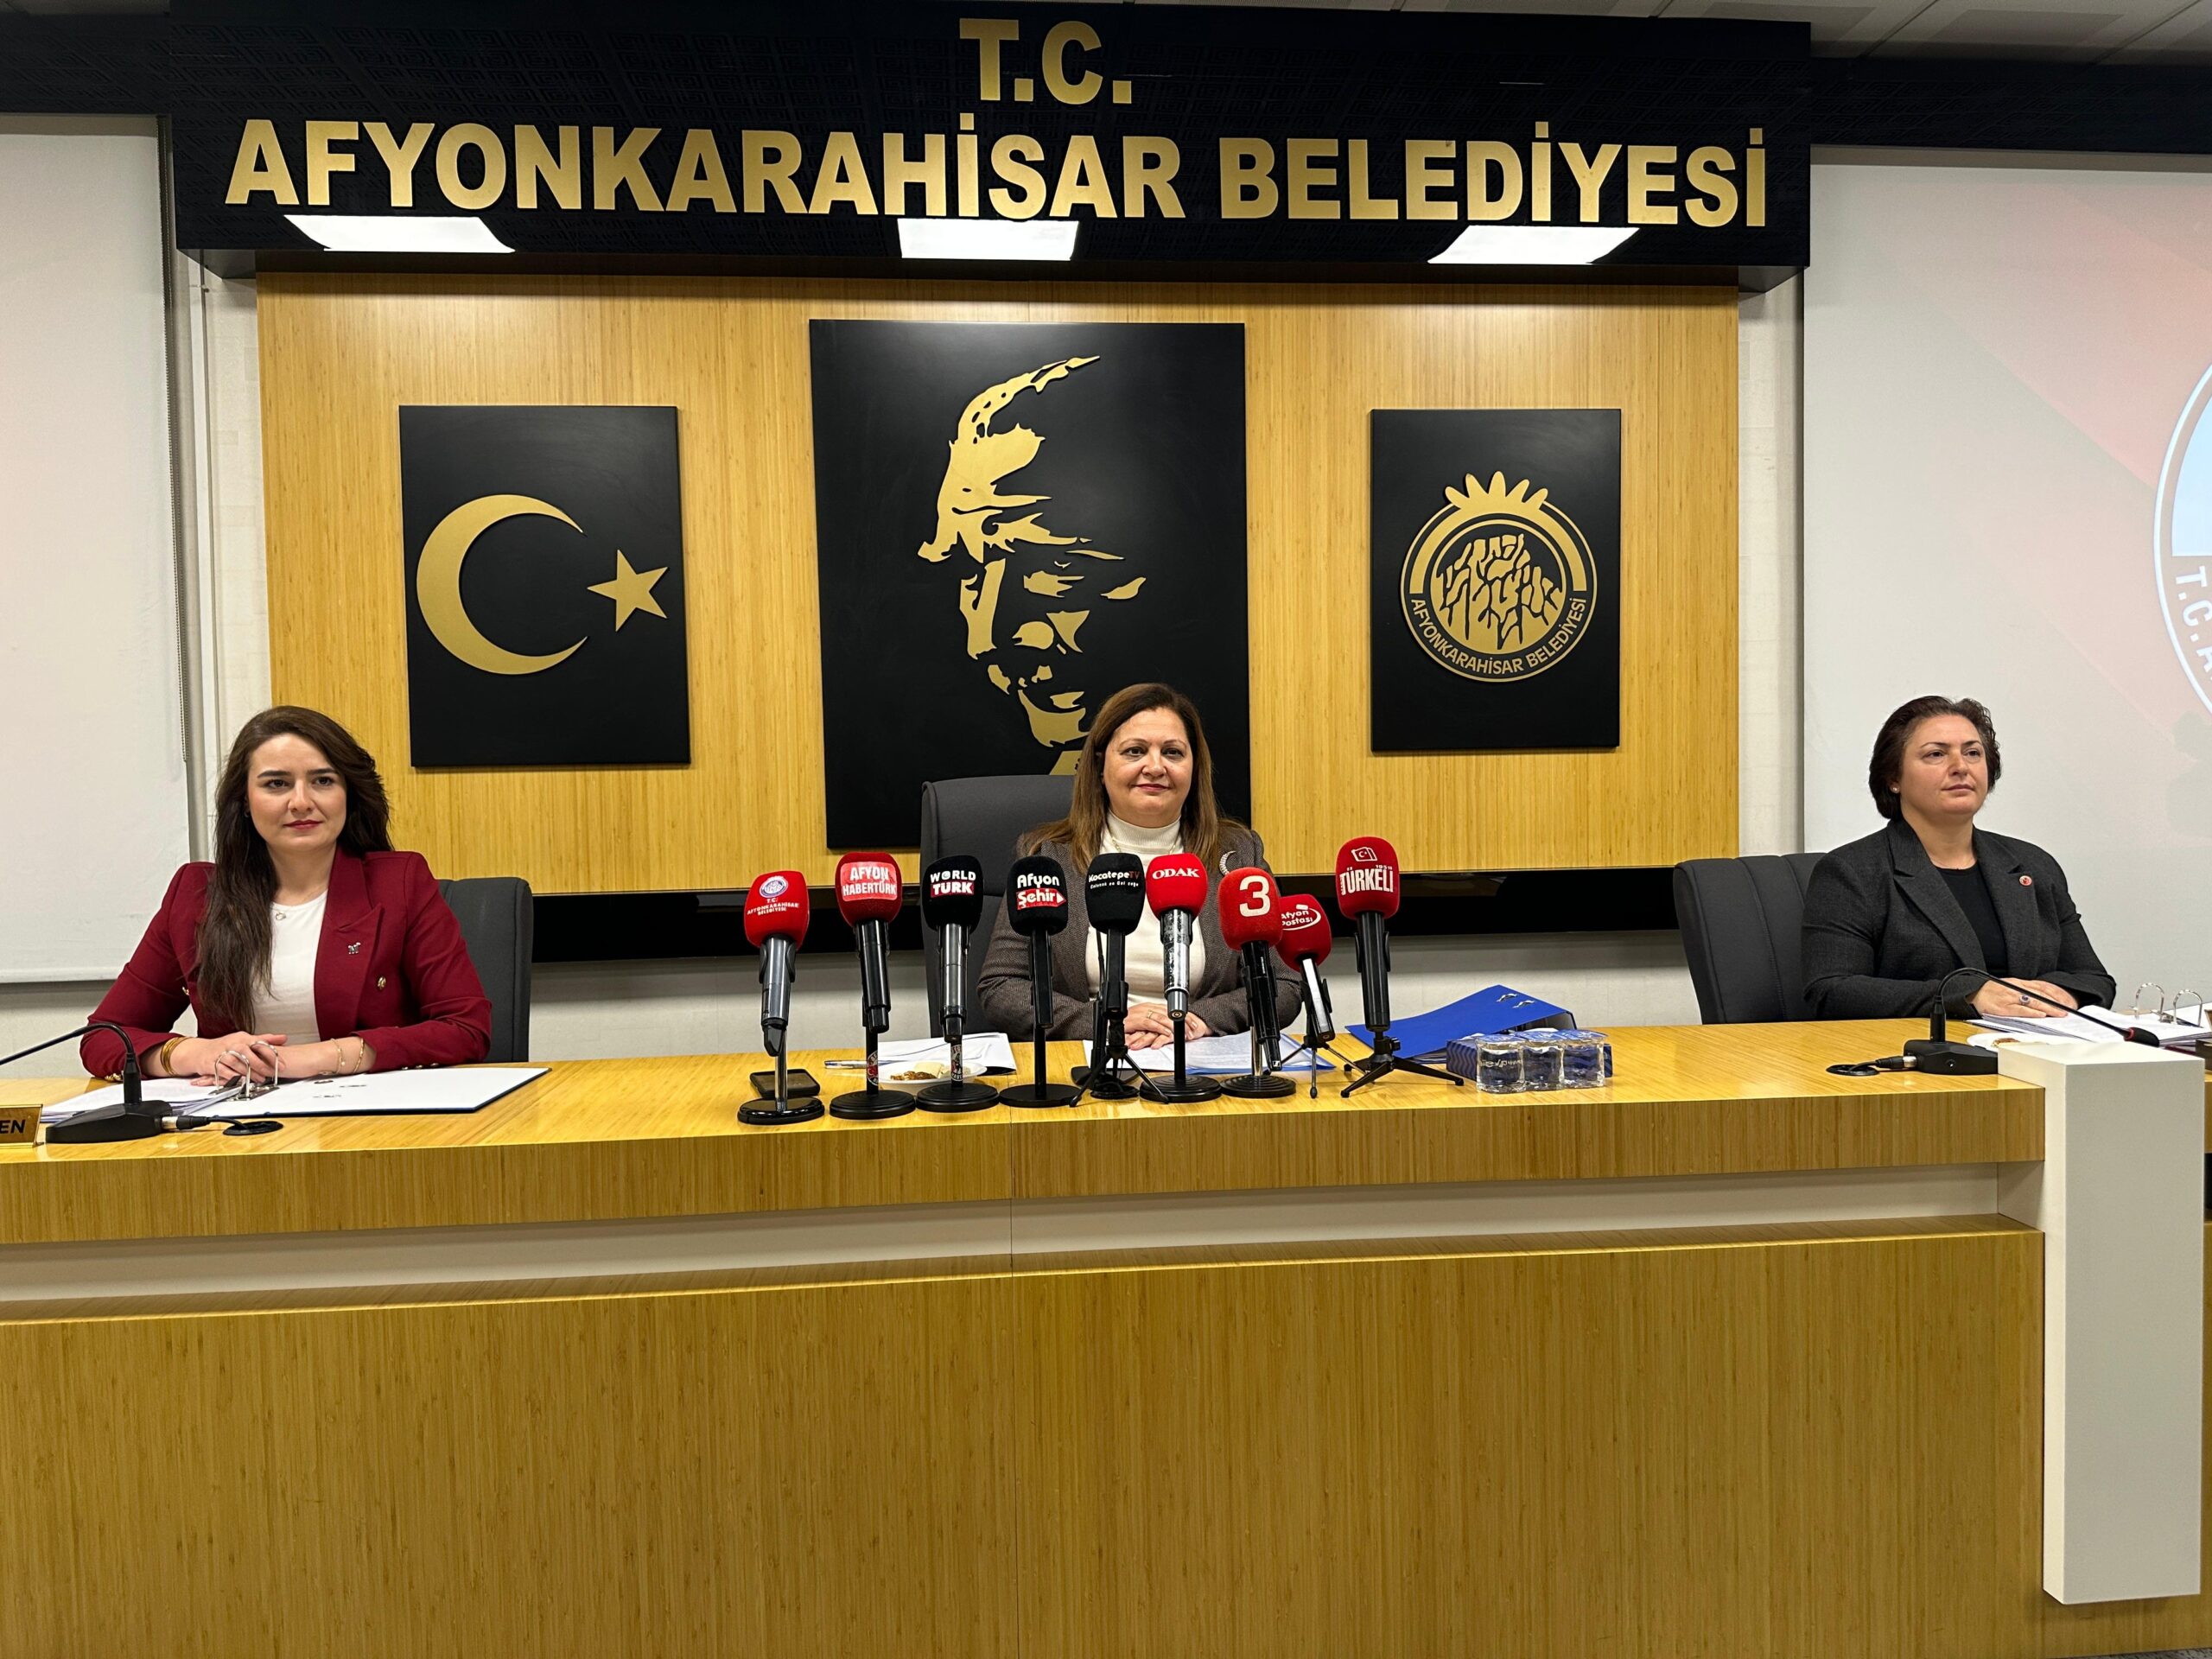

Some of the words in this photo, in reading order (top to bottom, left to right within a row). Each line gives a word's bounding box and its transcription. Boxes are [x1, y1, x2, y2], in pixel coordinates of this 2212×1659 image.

[958, 19, 1134, 105] T.C.
[225, 112, 1184, 221] AFYONKARAHİSAR
[1218, 120, 1767, 228] BELEDİYESİ
[1411, 598, 1524, 675] AFYONKARAHİSAR
[1524, 597, 1587, 669] BELEDİYESİ
[849, 866, 889, 881] AFYON
[930, 869, 976, 883] WORLD
[1017, 873, 1060, 889] Afyon
[1152, 868, 1200, 880] ODAK
[1339, 866, 1394, 896] TÜRKELİ
[842, 879, 897, 897] HABERTÜRK
[1239, 875, 1271, 918] 3
[1017, 888, 1056, 909] Şehir
[1281, 910, 1309, 920] Afyon
